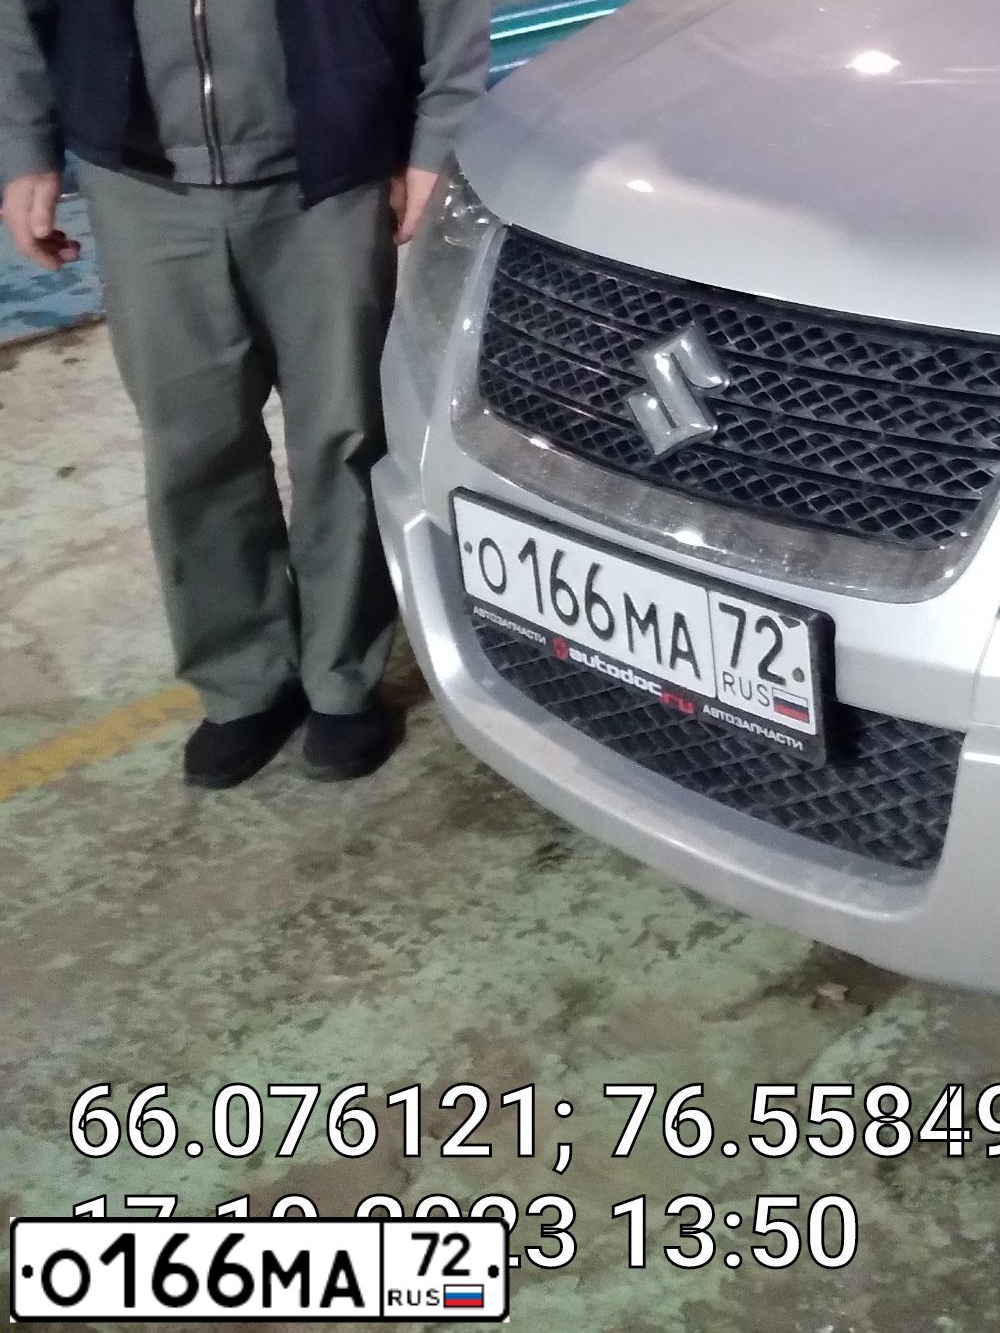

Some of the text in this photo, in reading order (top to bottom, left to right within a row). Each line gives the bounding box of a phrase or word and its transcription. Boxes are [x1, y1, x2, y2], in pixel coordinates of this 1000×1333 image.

[718, 601, 786, 686] 72
[722, 671, 771, 708] RUS
[702, 704, 804, 751] АВТОЗАПЧАСТИ
